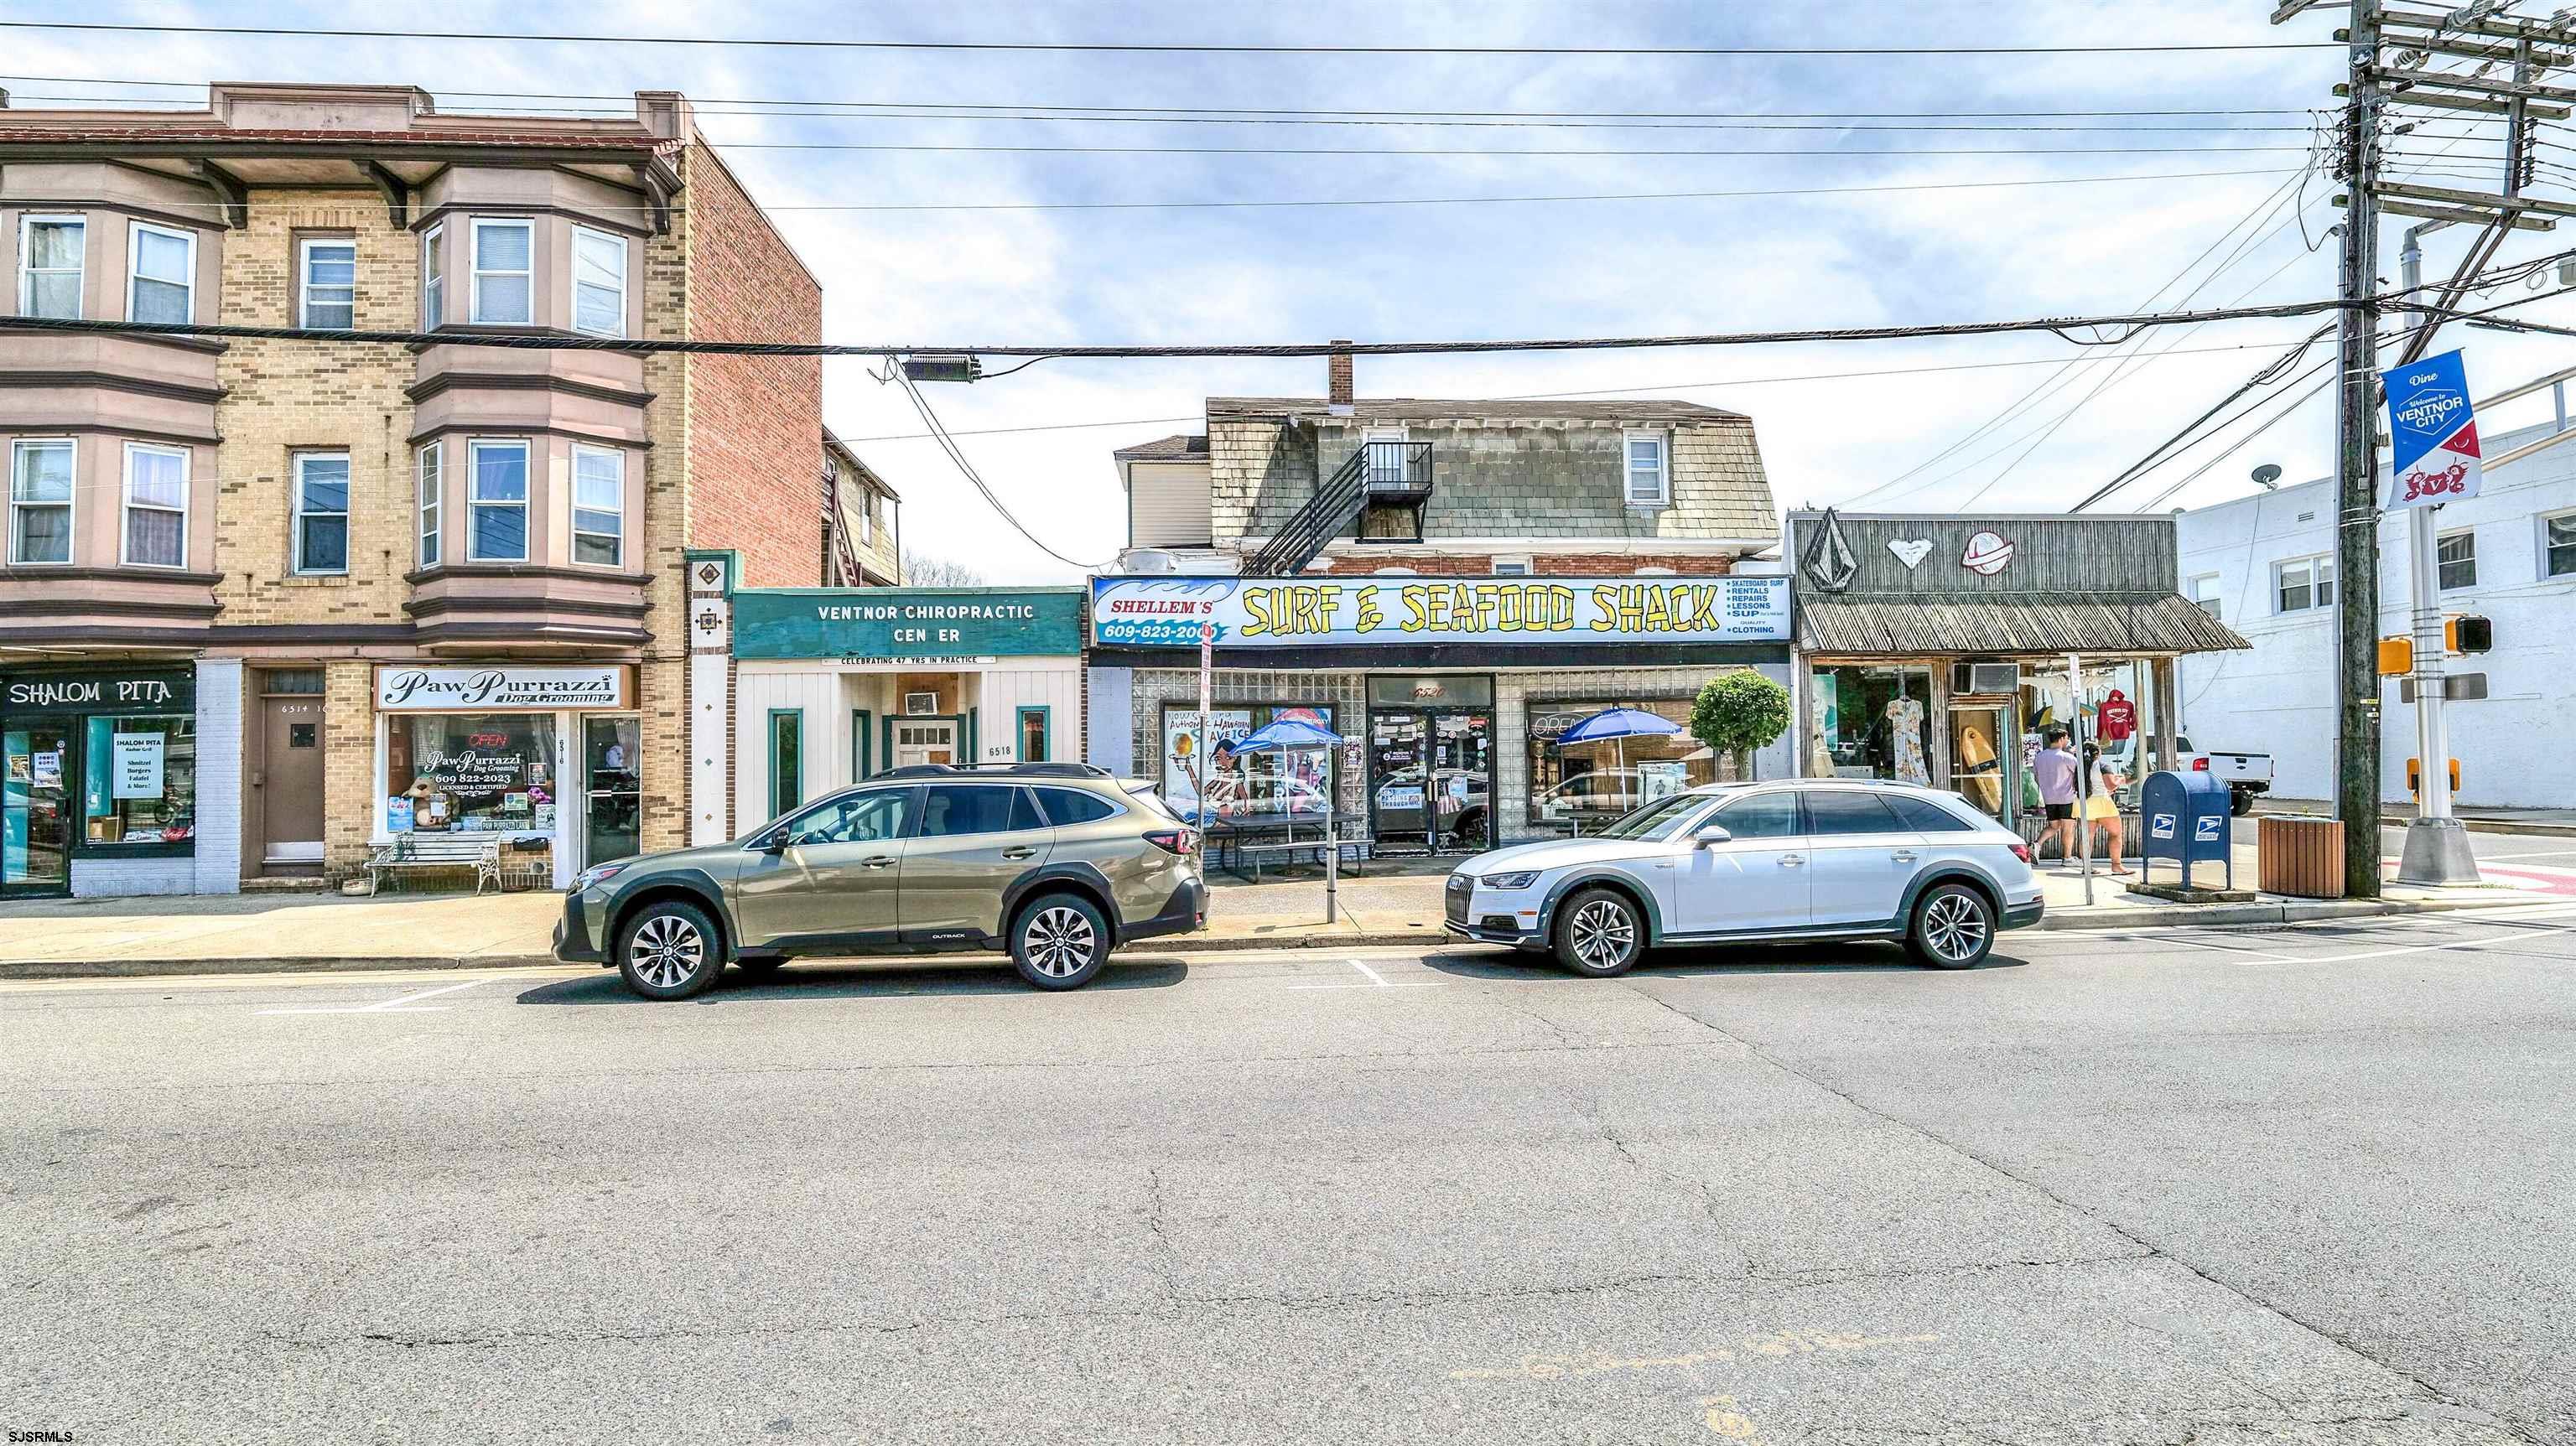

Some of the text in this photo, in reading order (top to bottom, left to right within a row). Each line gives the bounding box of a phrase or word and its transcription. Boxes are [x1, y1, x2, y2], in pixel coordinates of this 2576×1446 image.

[2409, 373, 2438, 386] Dine
[2409, 396, 2438, 407] Welcome
[2396, 396, 2464, 422] VENTNOR
[2416, 412, 2445, 428] CITY
[818, 605, 1034, 620] VENTNOR CHIROPRACTIC
[1240, 585, 1343, 637] SURF
[1400, 583, 1575, 633] SEAFOOD
[1589, 583, 1721, 633] SHACK
[10, 681, 172, 706] SHALOM PITA
[502, 693, 610, 705] Dog Grooming
[470, 733, 508, 746] OPEN
[989, 746, 1010, 756] 6518
[435, 774, 511, 784] 609 822-2023
